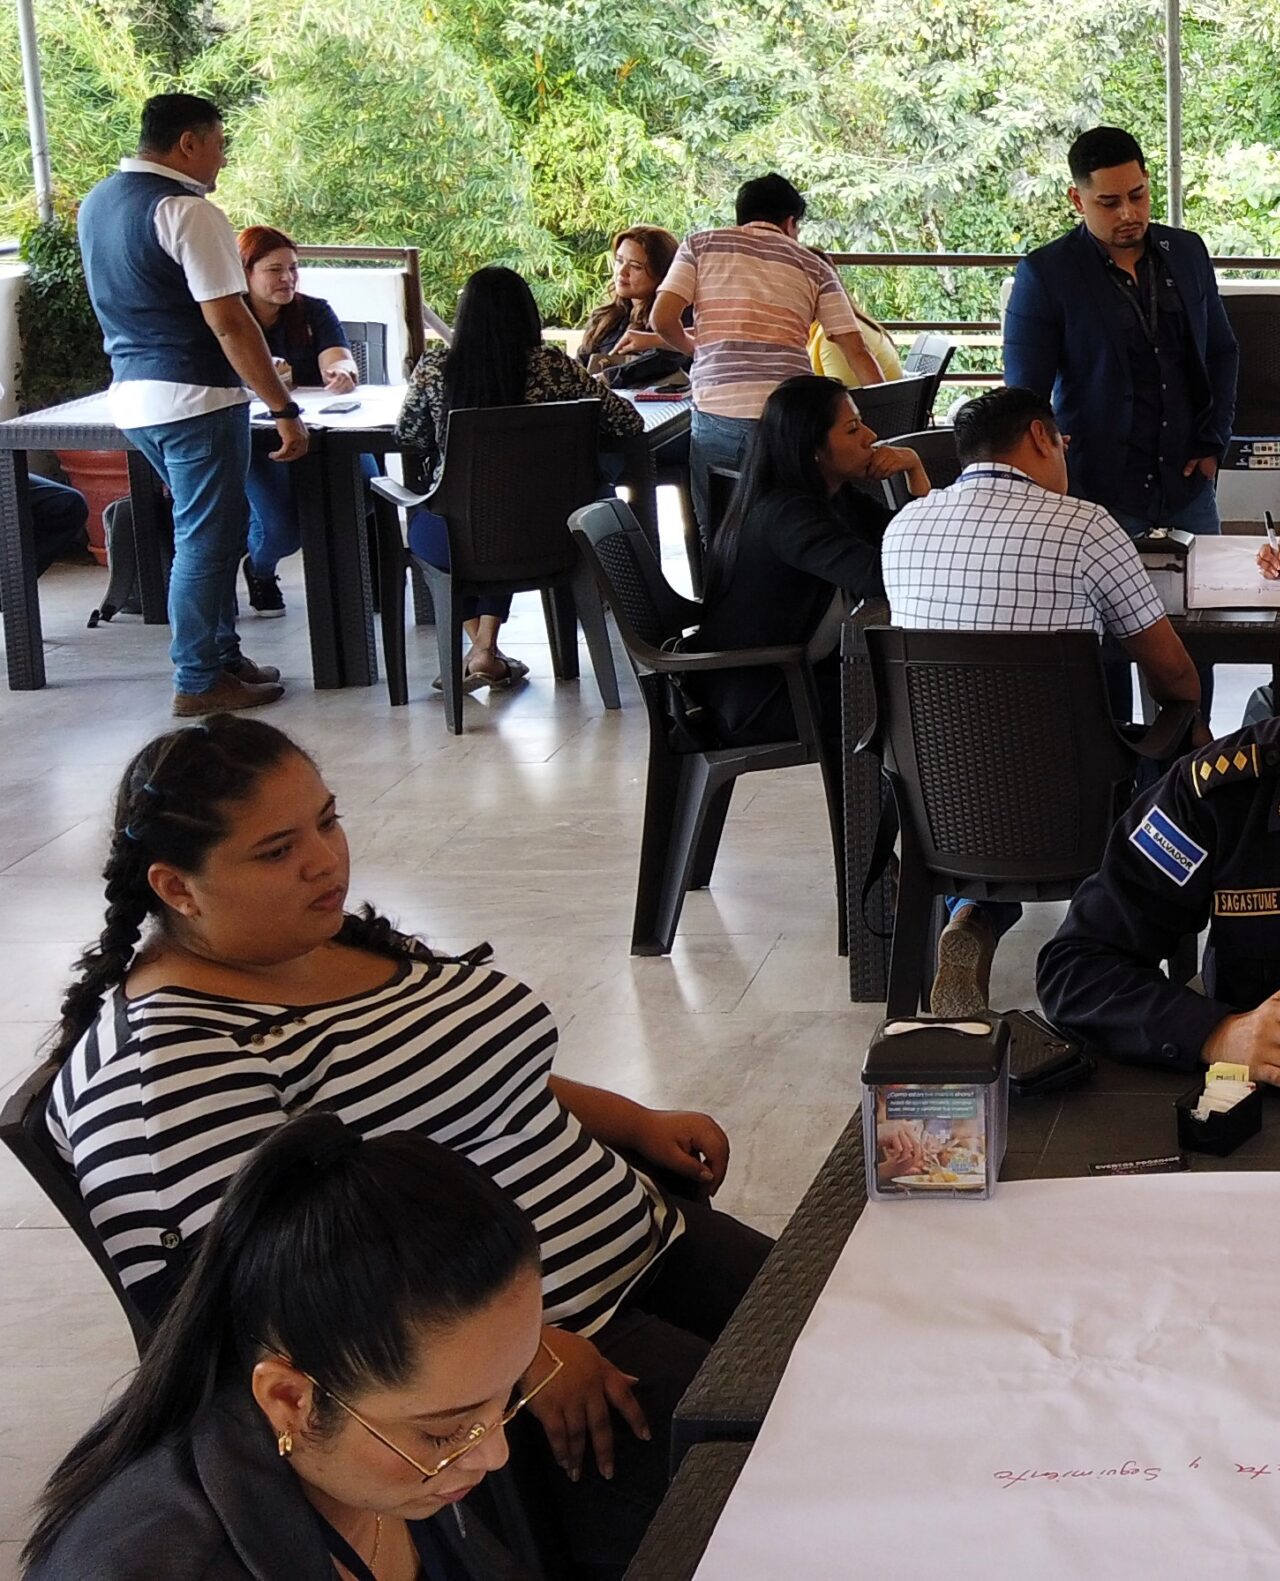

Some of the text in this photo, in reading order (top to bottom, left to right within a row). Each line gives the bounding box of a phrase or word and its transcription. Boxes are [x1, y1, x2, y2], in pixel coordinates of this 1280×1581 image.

[1143, 822, 1193, 870] EL SALVADOR
[1221, 891, 1278, 912] SAGASTUME
[993, 1460, 1162, 1489] Seguimiento
[1188, 1457, 1202, 1469] y
